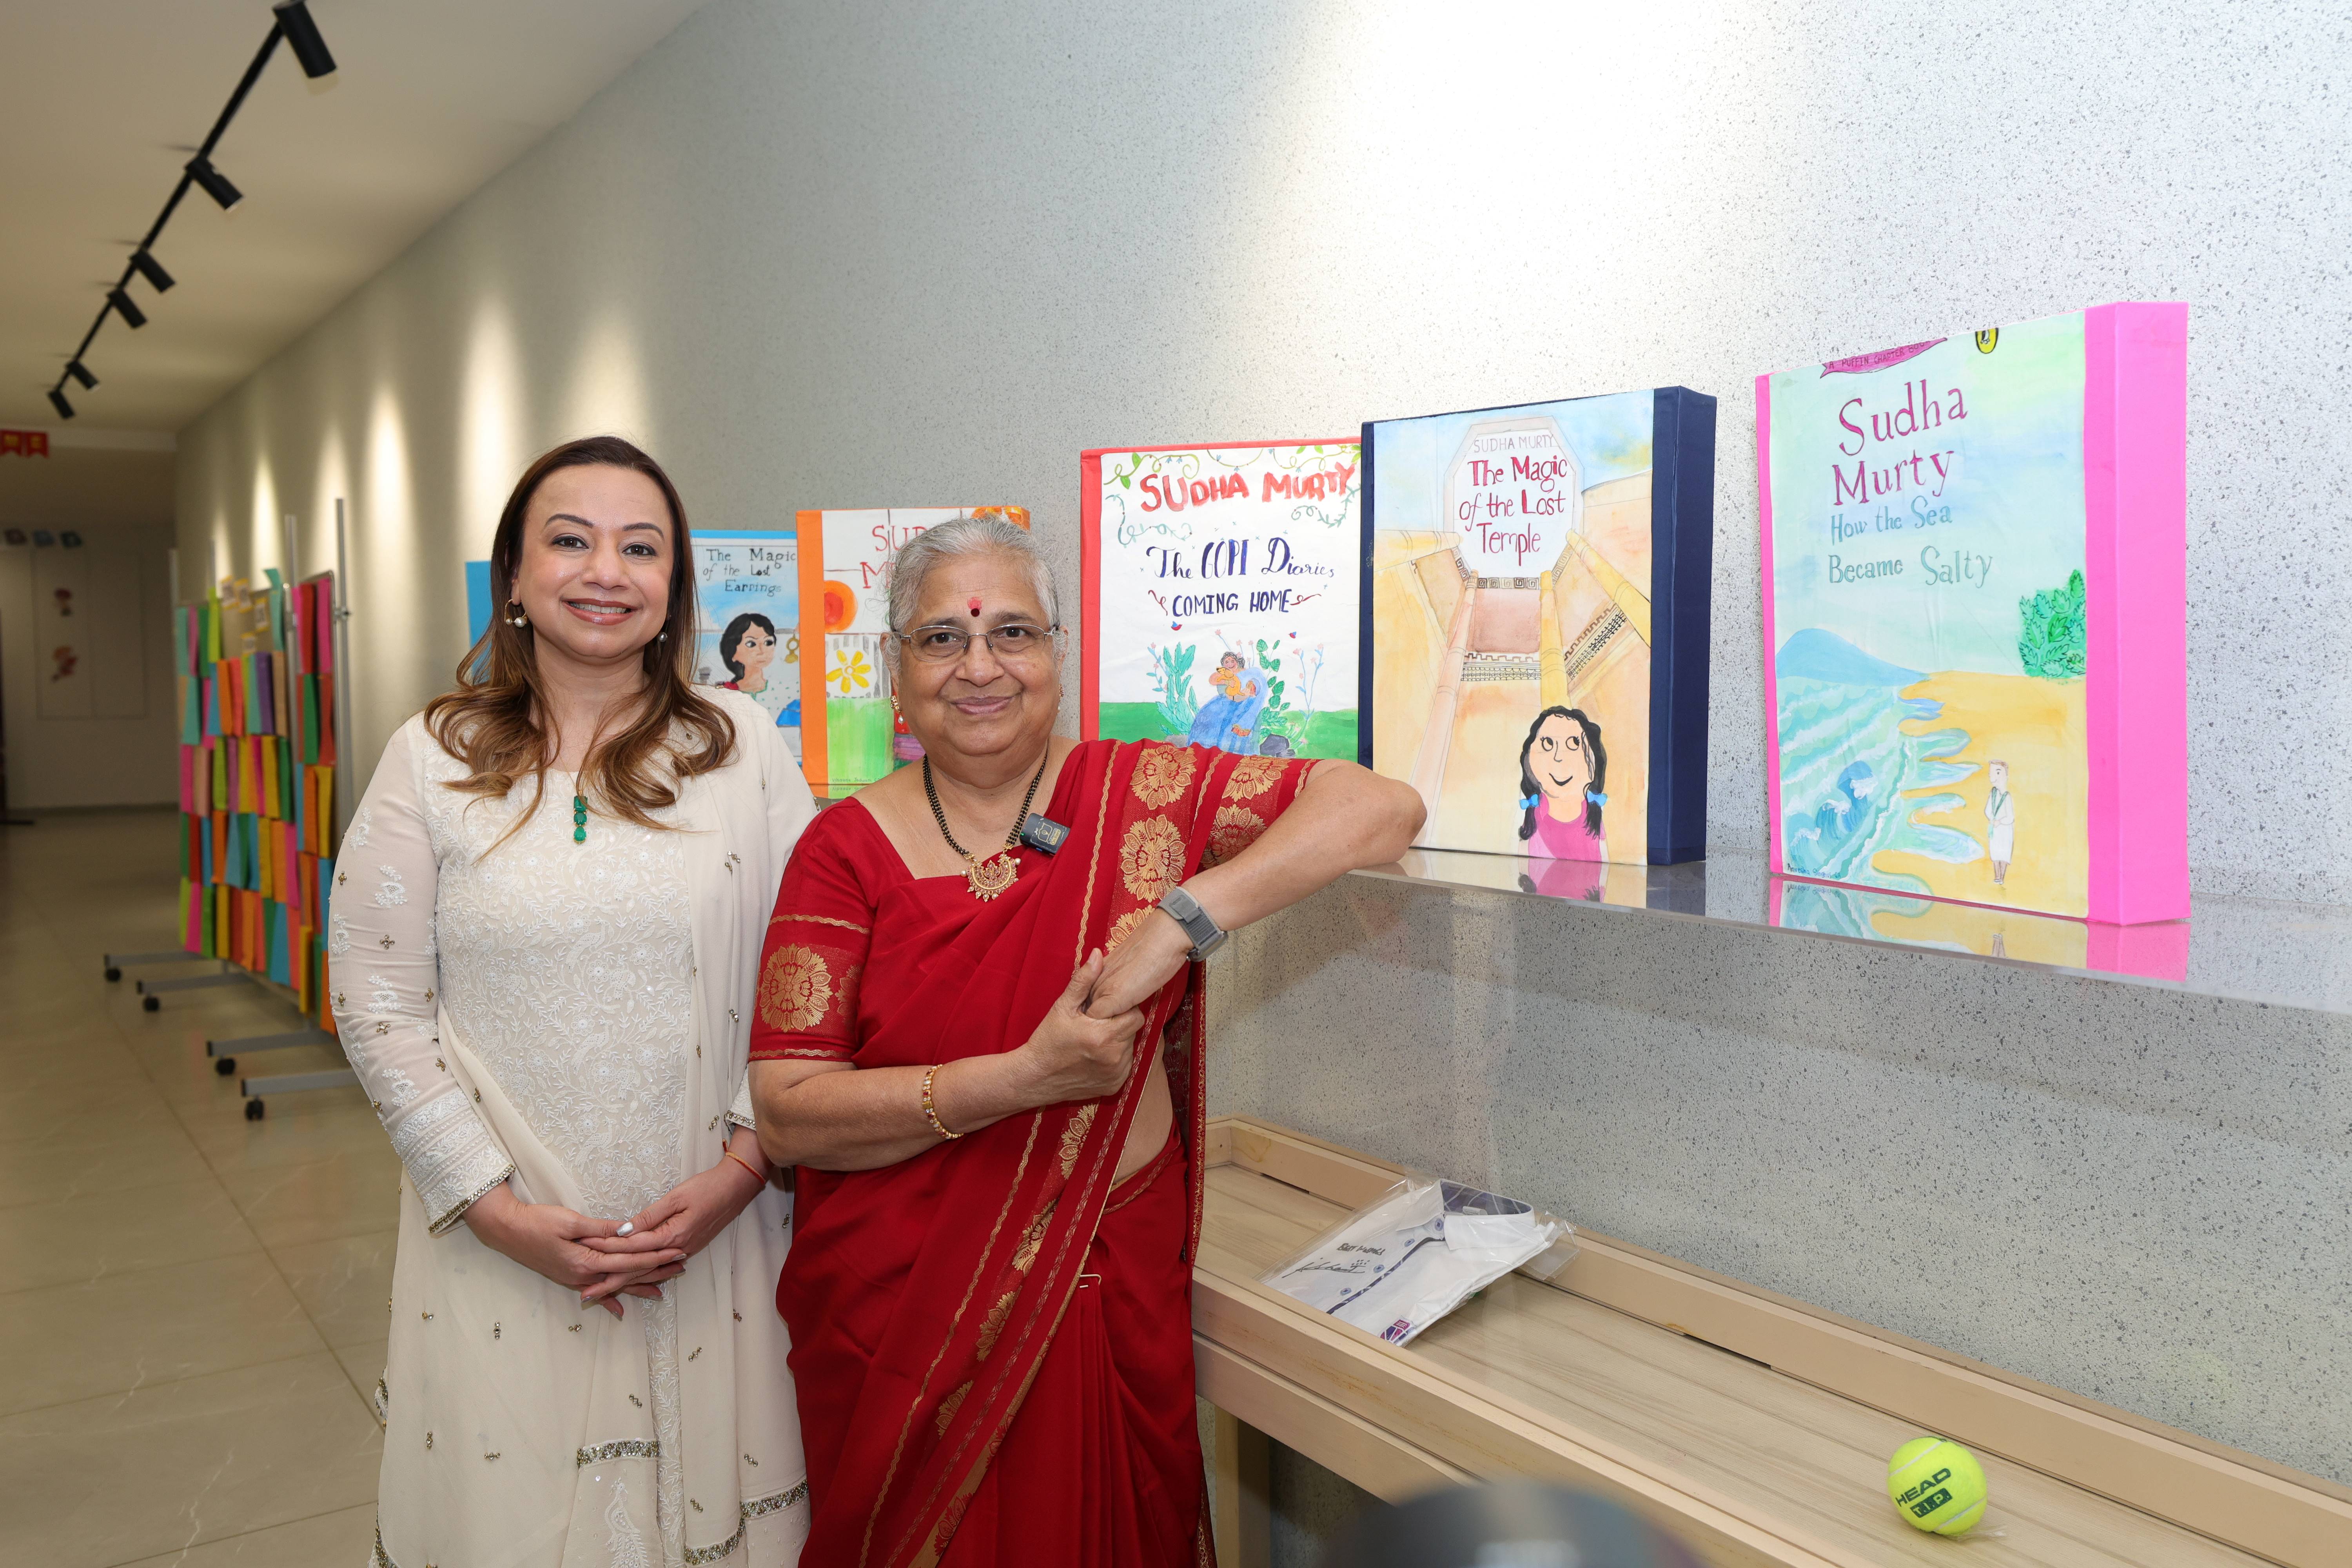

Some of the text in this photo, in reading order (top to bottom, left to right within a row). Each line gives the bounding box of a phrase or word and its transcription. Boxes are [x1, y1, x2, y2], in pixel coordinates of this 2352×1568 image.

[1829, 341, 1931, 369] A PUFFIN CHAPTER BOO
[1838, 379, 1968, 457] Sudha
[1474, 433, 1556, 454] SUDHA MURTY
[1140, 462, 1355, 512] SUDHA MURTY
[1468, 455, 1568, 492] The Magic
[1832, 450, 1955, 506] Murty
[1459, 489, 1566, 531] of the Lost
[1830, 495, 1953, 545] How the Sea
[706, 548, 796, 569] The Magic
[1146, 537, 1335, 579] The GOPI Diaries
[1477, 523, 1541, 566] Temple
[702, 563, 770, 581] of the Lost
[1828, 545, 1993, 588] Became Salty
[724, 579, 782, 597] Earrings
[1172, 588, 1292, 617] COMING HOME
[1788, 863, 1810, 875] Anvesha
[1895, 1468, 1951, 1507] HEAD
